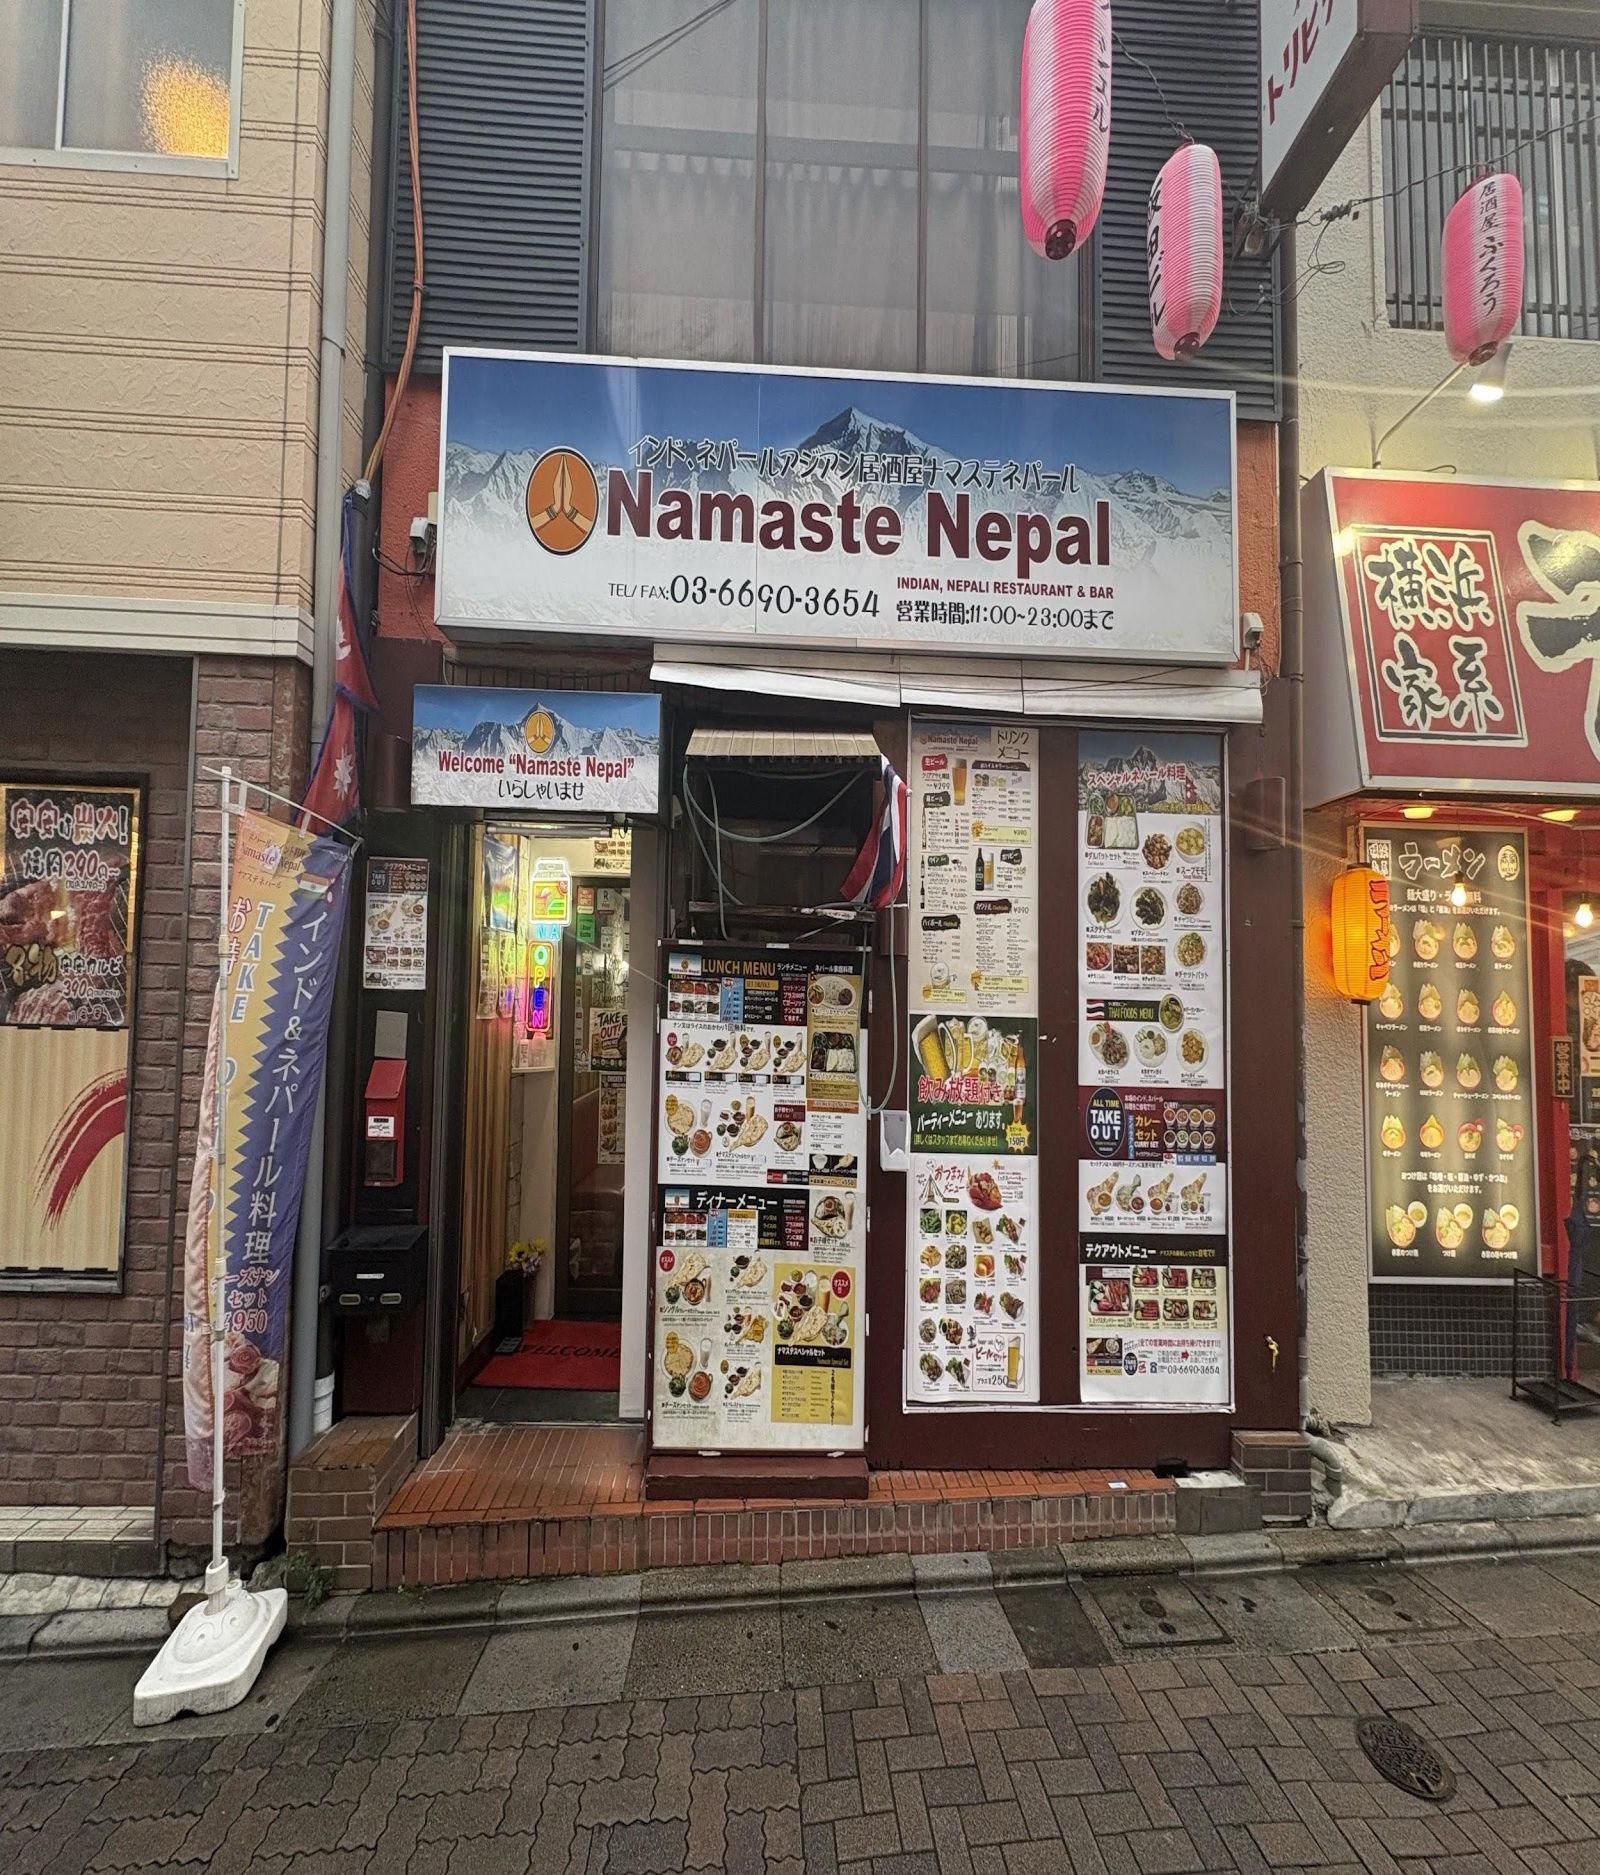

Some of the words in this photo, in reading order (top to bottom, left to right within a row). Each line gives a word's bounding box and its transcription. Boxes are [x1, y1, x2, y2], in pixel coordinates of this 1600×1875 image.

[628, 433, 1081, 495] インド、ネパールアジアン居酒屋ナマステネパール
[606, 468, 901, 557] Namaste
[926, 492, 1111, 579] Nepal
[896, 576, 943, 594] INDIAN,
[946, 579, 989, 593] NEPALI
[992, 581, 1072, 598] RESTAURANT
[1076, 585, 1086, 598] &
[1088, 587, 1114, 599] BAR
[1367, 540, 1491, 630] 横浜
[997, 730, 1029, 745] ドリンク
[438, 750, 505, 773] Welcome
[1087, 764, 1186, 787] スペシャルネパール料理
[498, 779, 585, 801] いらしゃいませ
[1398, 841, 1486, 880] ラーメン
[230, 902, 276, 1023] TAKE
[701, 958, 741, 975] LUNCH
[742, 960, 776, 977] MENU
[531, 944, 549, 1028] OPEN
[598, 1012, 621, 1027] TAKE
[600, 1024, 622, 1039] OUT!
[1556, 1042, 1572, 1094] 営業中
[242, 911, 328, 1265] インド&ネパール料理
[918, 1076, 1002, 1104] 飲み放題付き
[1092, 1099, 1103, 1108] ALL
[917, 1110, 973, 1132] パーティーメニュー
[975, 1110, 1005, 1130] あります。
[1090, 1109, 1121, 1125] TAKE
[1135, 1115, 1161, 1128] カレー
[1090, 1126, 1121, 1140] OUT
[1135, 1131, 1157, 1141] セット
[934, 1164, 966, 1181] おつまみ
[696, 1191, 778, 1210] ディナーメニュー
[1085, 1243, 1157, 1259] テクアウトメニュー
[227, 1289, 269, 1310] セット
